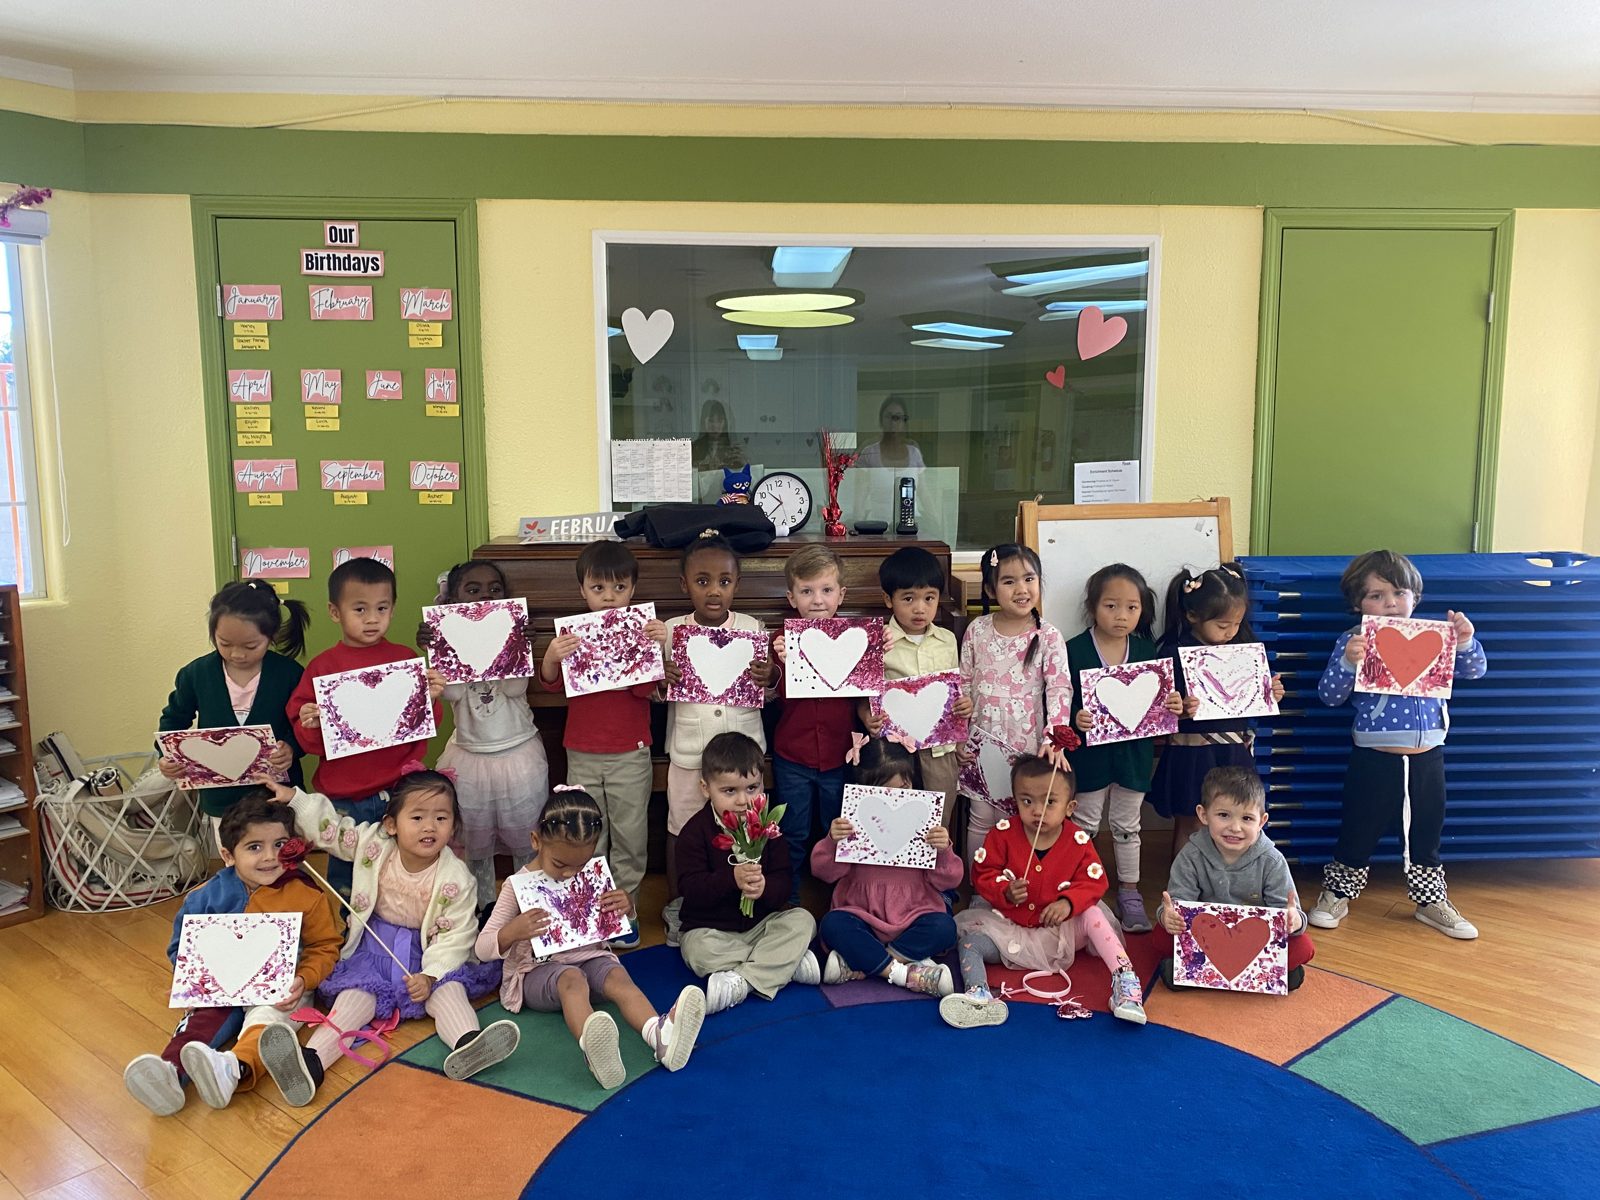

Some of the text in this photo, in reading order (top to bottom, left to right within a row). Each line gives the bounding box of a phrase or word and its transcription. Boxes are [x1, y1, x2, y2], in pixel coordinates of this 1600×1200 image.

[328, 225, 355, 244] Our
[305, 252, 380, 273] Birthdays
[226, 287, 279, 315] January
[311, 289, 370, 318] February
[402, 290, 450, 315] March
[232, 371, 270, 400] April
[304, 371, 340, 399] May
[367, 372, 400, 398] June
[427, 371, 454, 400] July
[237, 463, 295, 491] August
[322, 460, 382, 490] September
[412, 461, 458, 489] October
[774, 480, 783, 488] 12
[759, 491, 767, 499] 10
[766, 483, 773, 492] 11
[794, 487, 801, 496] 2
[770, 516, 777, 524] 7
[781, 518, 787, 526] 6
[790, 515, 797, 523] 5
[797, 507, 803, 515] 4
[550, 515, 620, 535] FEBRUA
[244, 550, 308, 577] November
